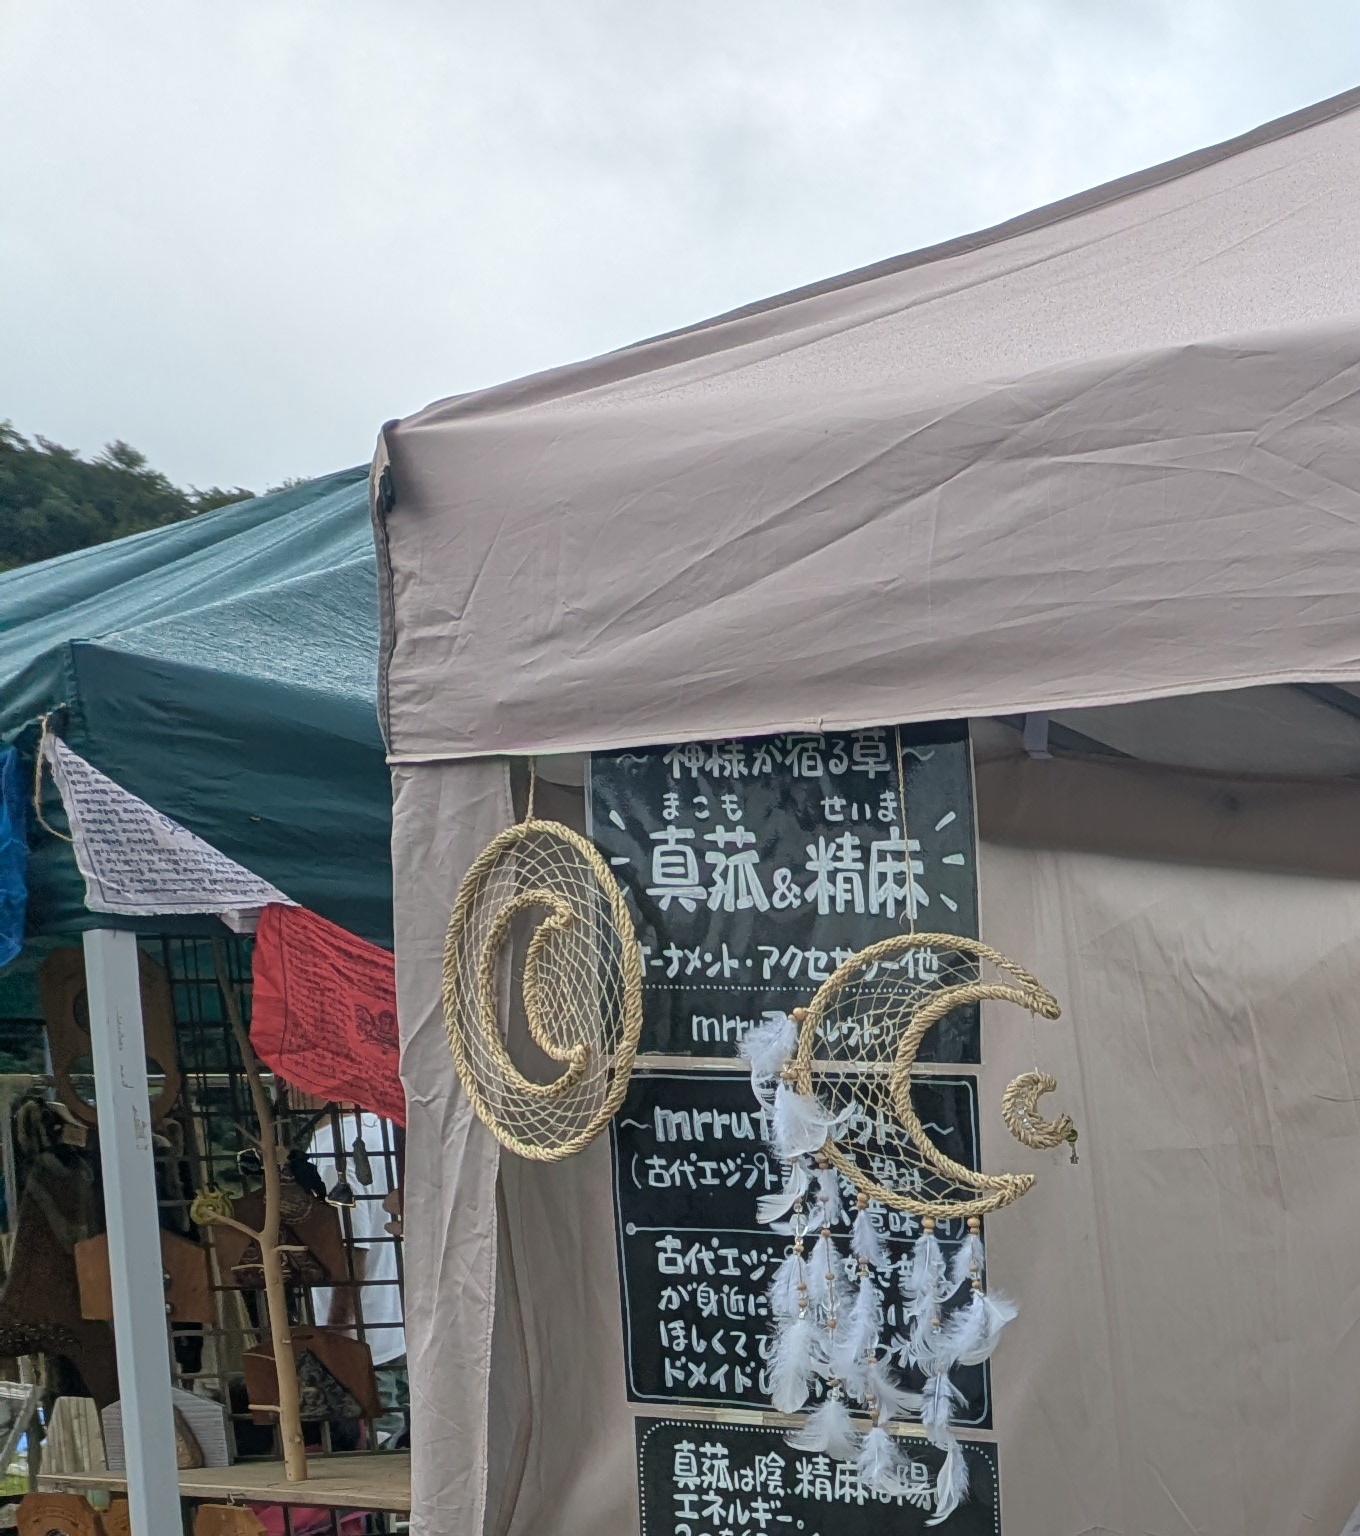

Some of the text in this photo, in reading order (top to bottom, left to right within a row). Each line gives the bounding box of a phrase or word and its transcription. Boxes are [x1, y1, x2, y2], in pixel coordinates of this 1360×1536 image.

[663, 789, 899, 822] まこも せいま
[674, 1492, 804, 1530] エネルギー。
